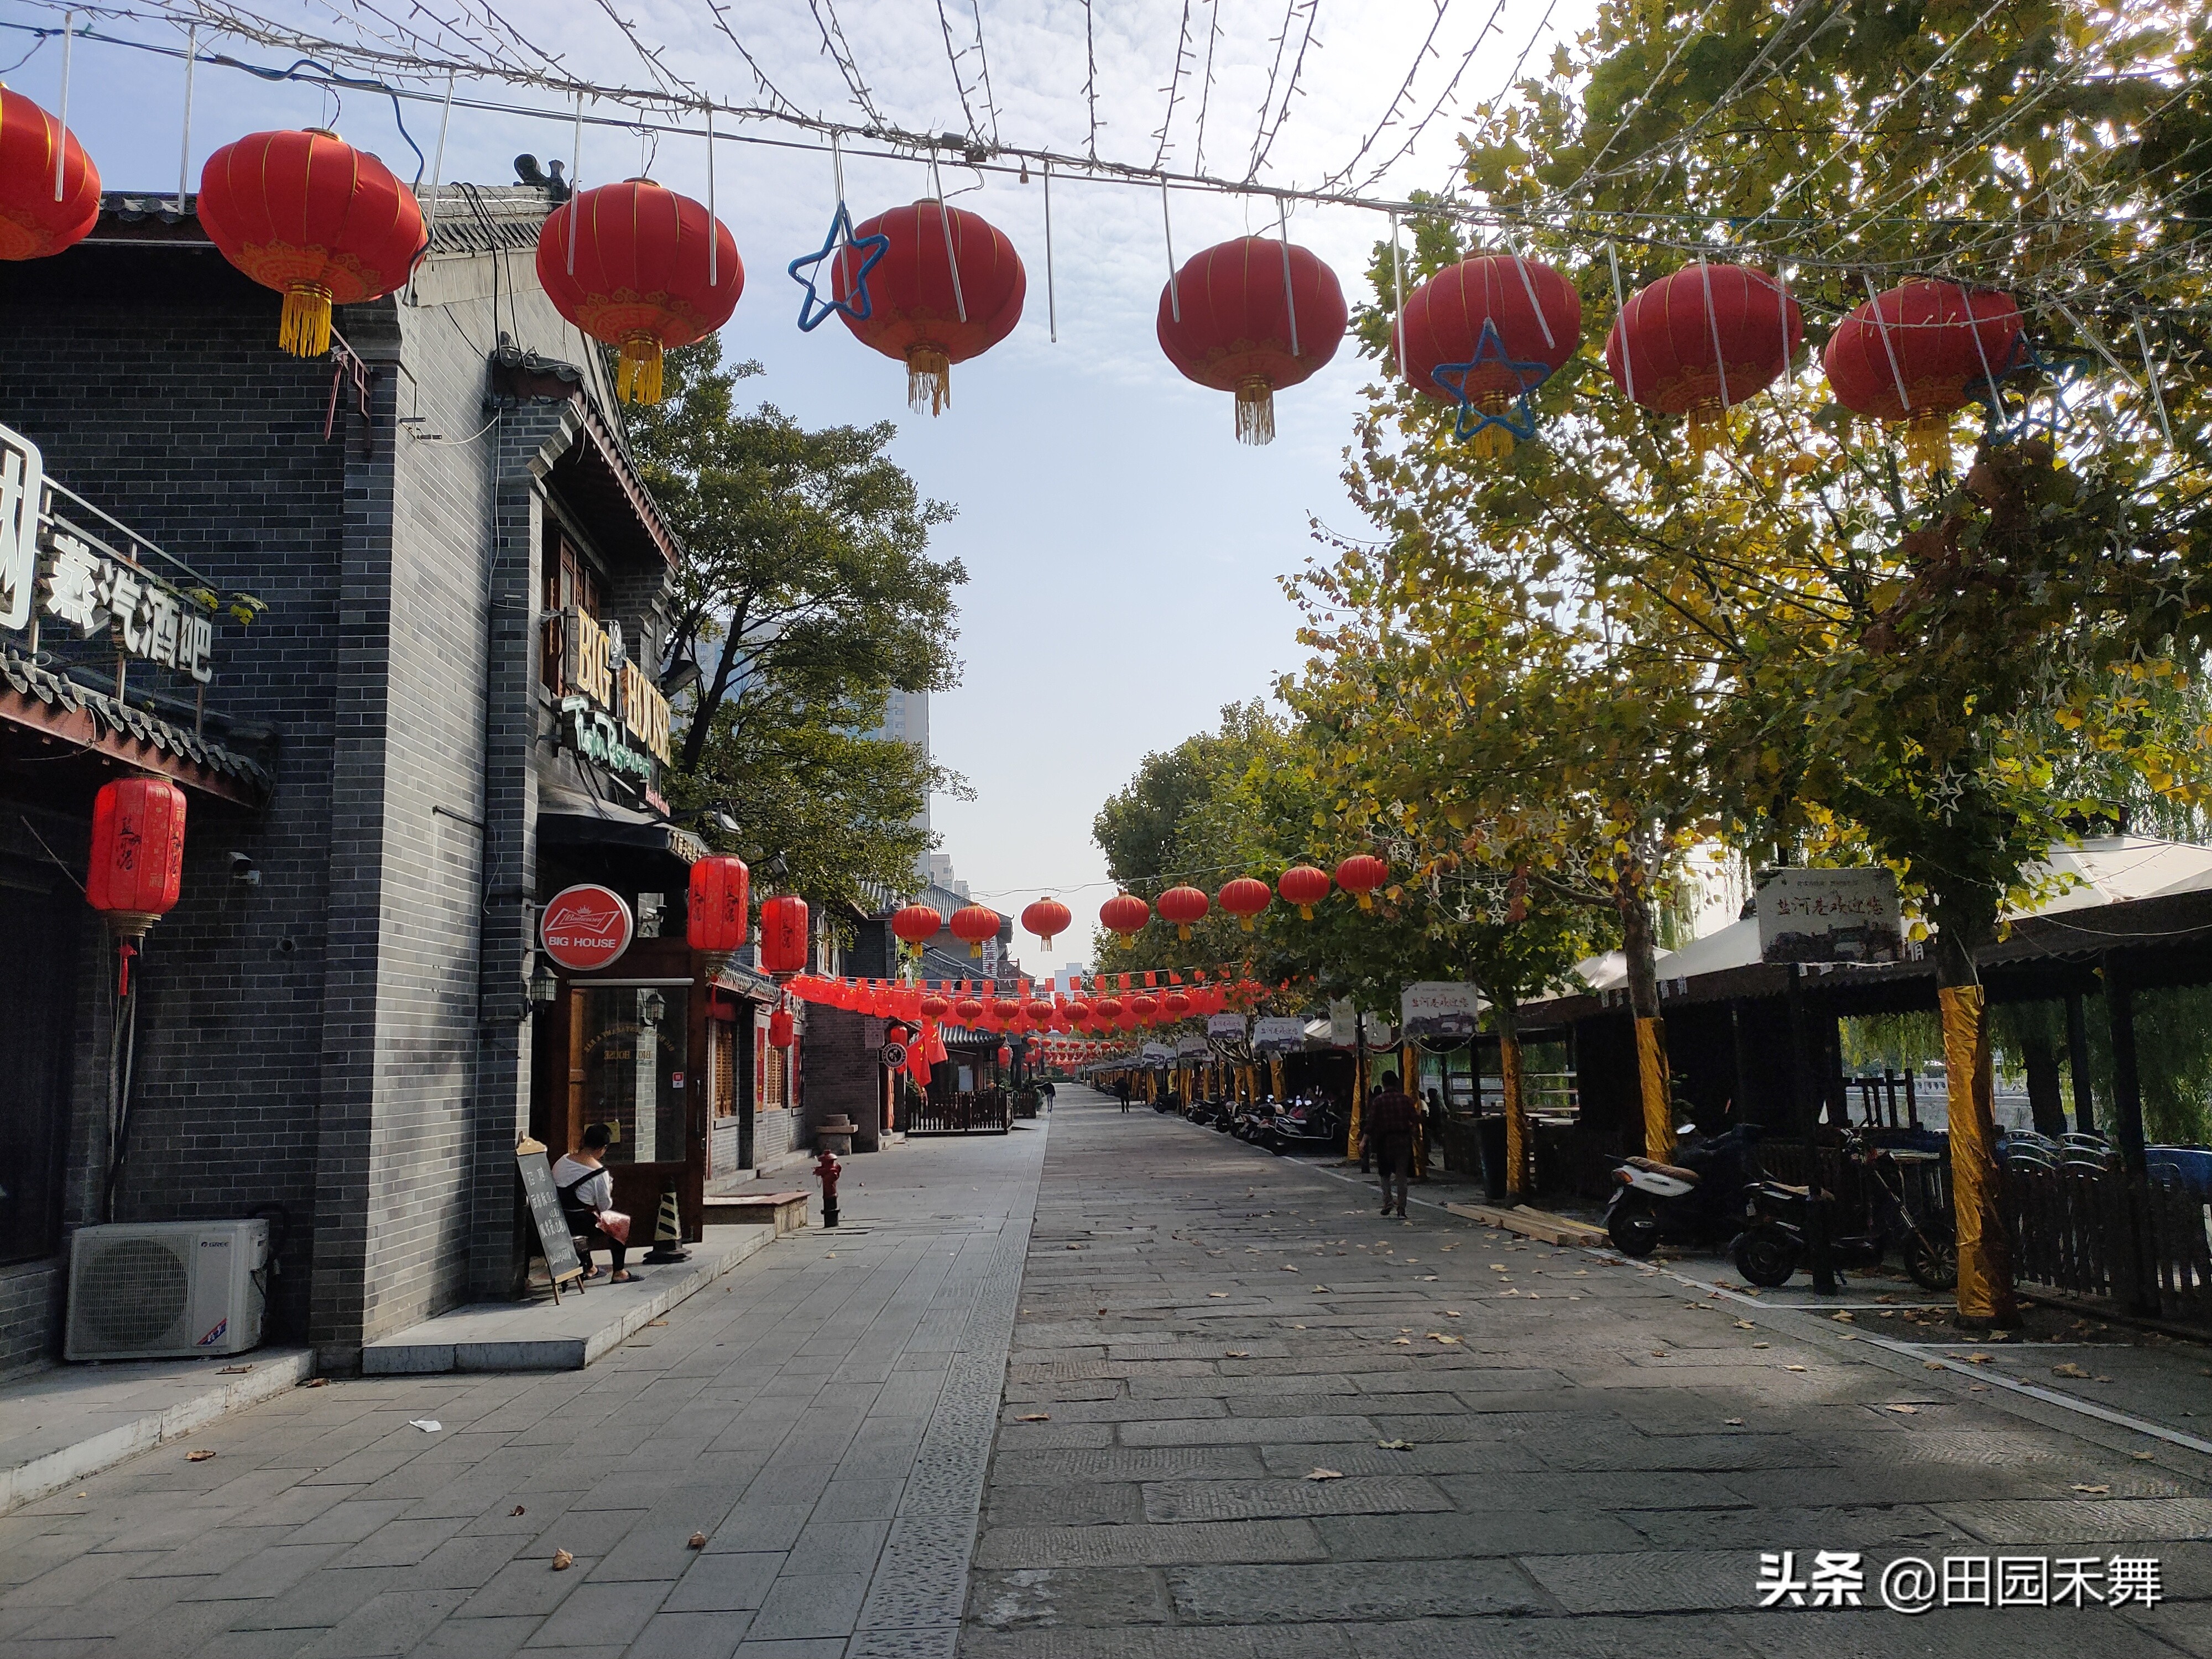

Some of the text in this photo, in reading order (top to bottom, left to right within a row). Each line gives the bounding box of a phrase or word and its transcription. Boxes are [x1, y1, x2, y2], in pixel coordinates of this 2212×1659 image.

[48, 533, 212, 683] 蒸汽酒吧
[577, 604, 612, 711] BIG
[626, 657, 671, 768] HOUSE
[549, 936, 616, 948] BIG HOUSE
[565, 914, 602, 922] Budweiser
